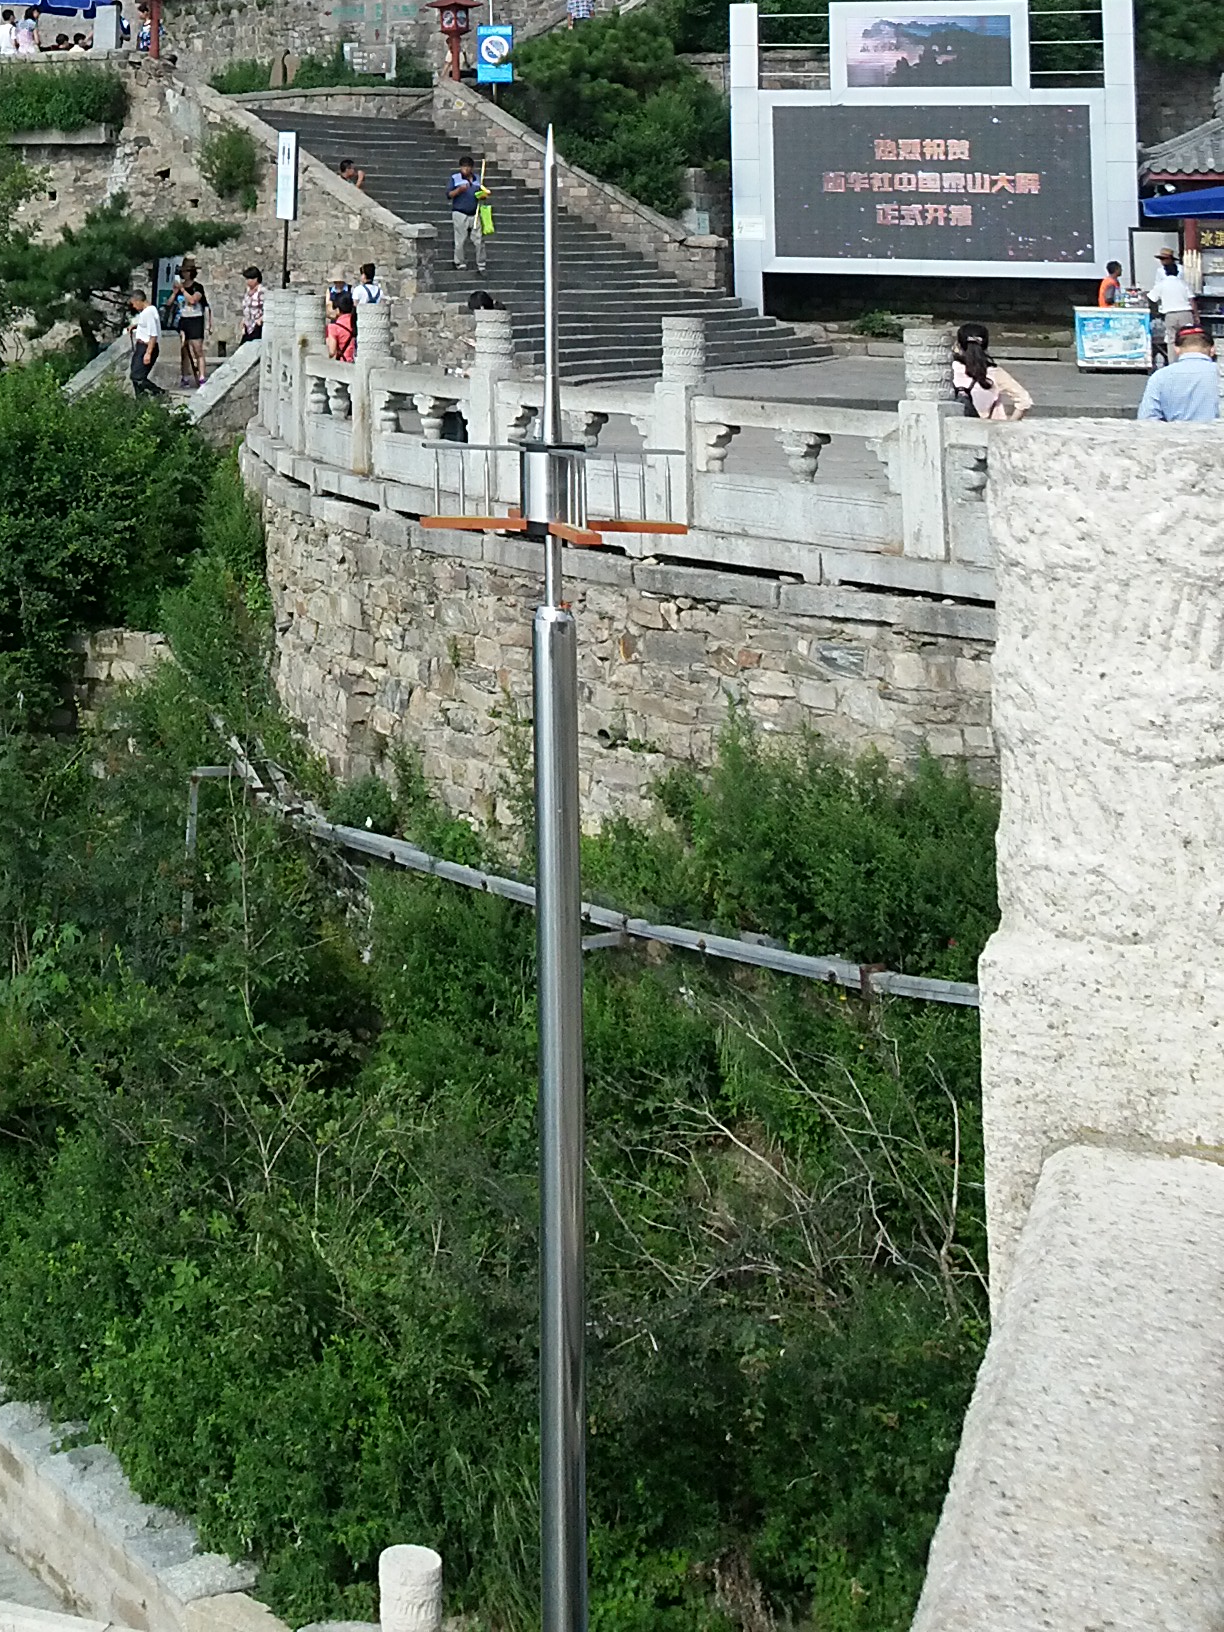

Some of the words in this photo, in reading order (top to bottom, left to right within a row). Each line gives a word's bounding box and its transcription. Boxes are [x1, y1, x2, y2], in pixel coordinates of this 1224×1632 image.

[873, 138, 970, 161] 热烈祝贺
[875, 204, 973, 227] 正式开播
